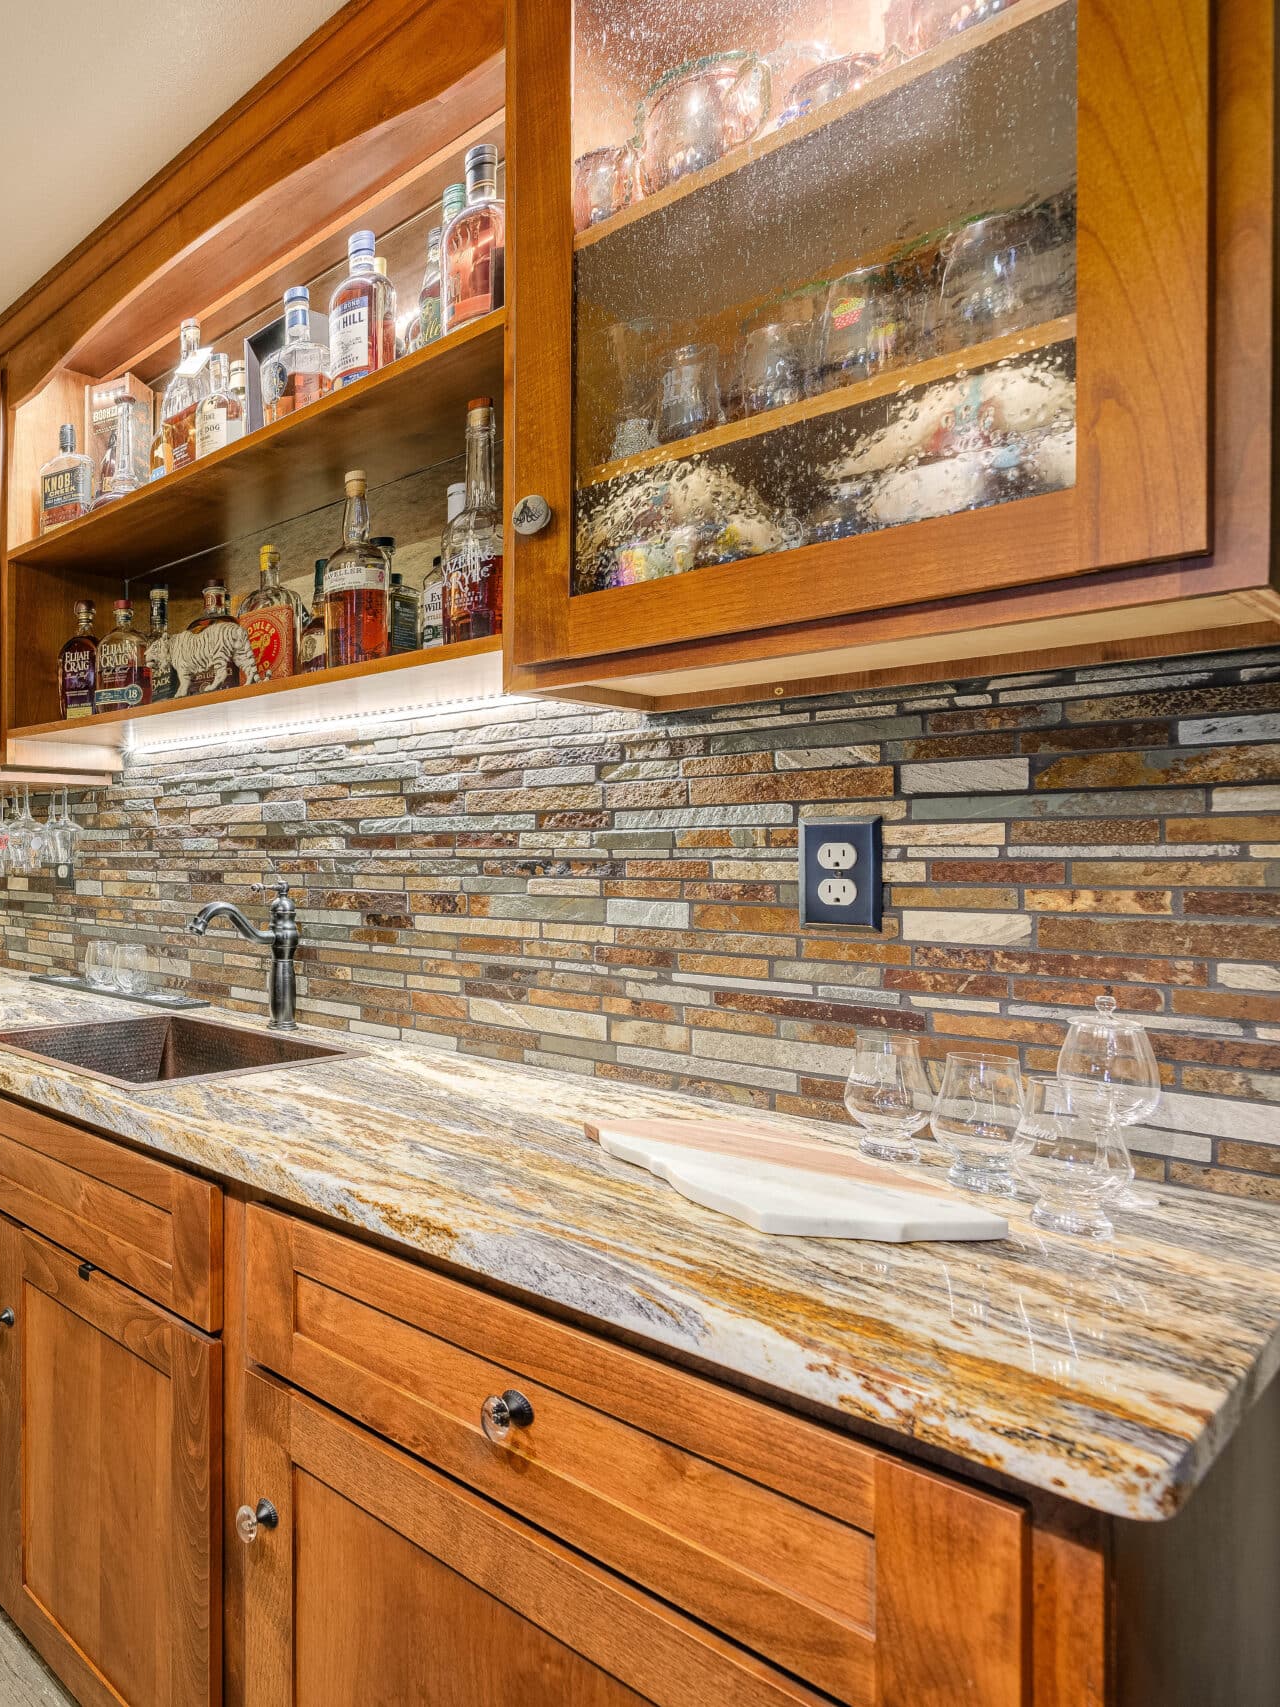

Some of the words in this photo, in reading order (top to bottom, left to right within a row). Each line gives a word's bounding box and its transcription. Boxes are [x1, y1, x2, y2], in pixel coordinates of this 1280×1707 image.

[342, 311, 364, 329] HILL
[44, 472, 71, 493] KNOB
[49, 485, 77, 497] CREEK
[430, 592, 442, 603] Ev
[423, 603, 442, 613] Will
[248, 621, 276, 637] OWLER
[101, 642, 130, 656] ELIJAH
[65, 650, 90, 662] ELIJAH
[101, 654, 129, 668] CRAIG
[64, 660, 90, 673] CRAIG
[127, 689, 138, 699] 18
